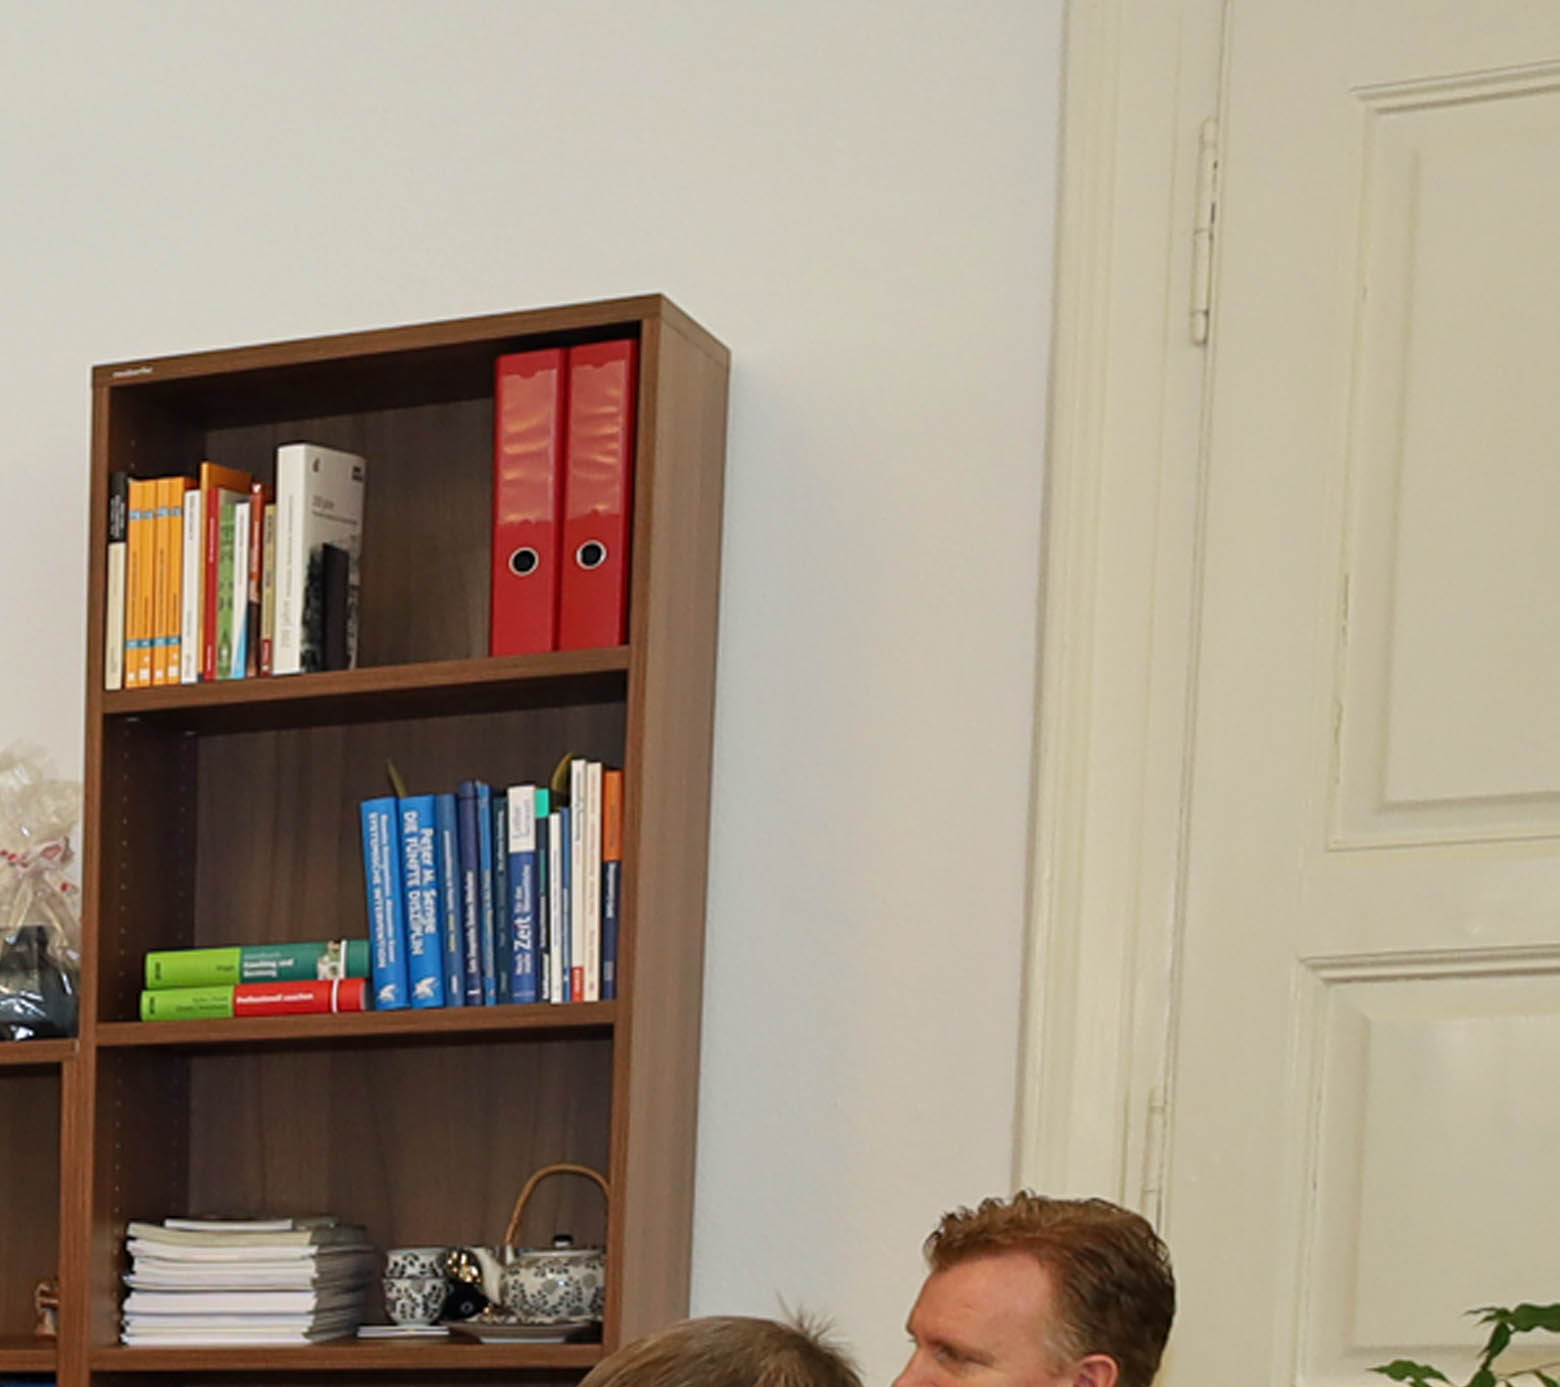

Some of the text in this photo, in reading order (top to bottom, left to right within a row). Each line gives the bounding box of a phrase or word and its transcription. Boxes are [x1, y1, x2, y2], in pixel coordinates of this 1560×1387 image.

[403, 811, 425, 956] DIE FÜNFTE DISZIPLIN
[420, 827, 438, 934] Peter M. Senge
[513, 915, 532, 951] Zeit
